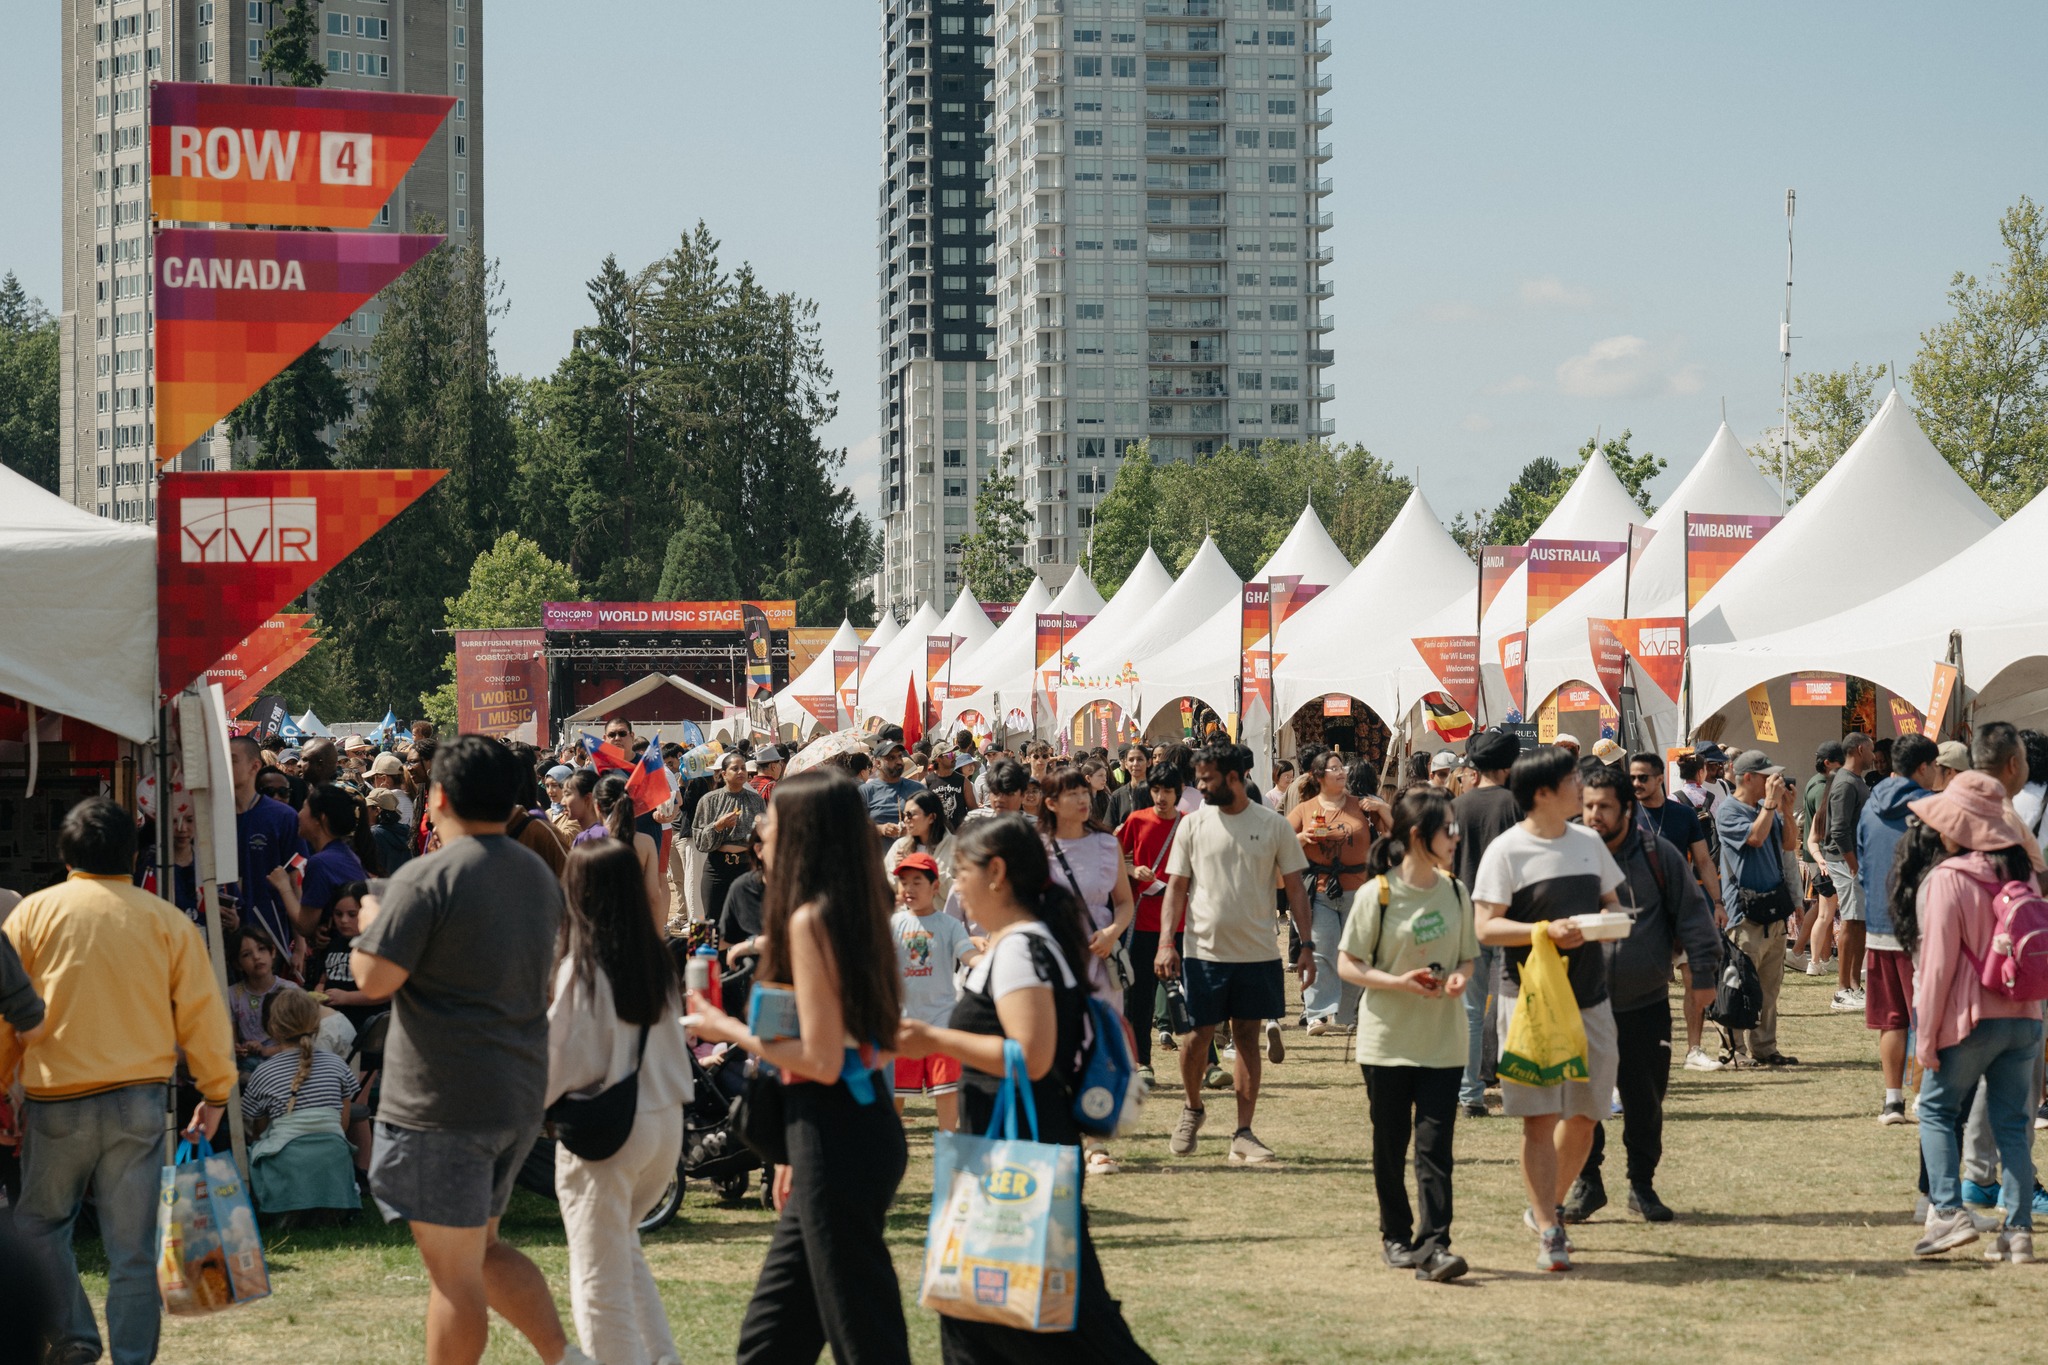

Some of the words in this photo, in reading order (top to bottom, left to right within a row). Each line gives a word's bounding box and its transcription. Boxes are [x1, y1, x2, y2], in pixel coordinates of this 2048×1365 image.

[170, 126, 301, 182] ROW
[336, 140, 358, 178] 4
[163, 256, 307, 291] CANADA
[1688, 523, 1753, 539] ZIMBABWE
[181, 523, 314, 562] YVR
[1482, 556, 1504, 568] GANDA
[1530, 548, 1601, 562] AUSTRALIA
[1245, 591, 1269, 604] GHA
[599, 610, 648, 622] WORLD
[651, 610, 695, 622] MUSIC
[698, 609, 742, 622] STAGE
[462, 640, 487, 648] SURREY
[1639, 638, 1680, 655] YVR
[475, 652, 529, 662] coastcapital
[1459, 652, 1476, 661] Leng
[1601, 651, 1622, 661] Welcome
[202, 669, 244, 677] nvenue
[481, 688, 528, 706] WORLD
[1569, 691, 1590, 701] WELCOME
[1750, 700, 1770, 717] ORDER
[488, 708, 532, 725] MUSIC
[1756, 720, 1773, 736] HERE
[1899, 718, 1918, 735] HERE
